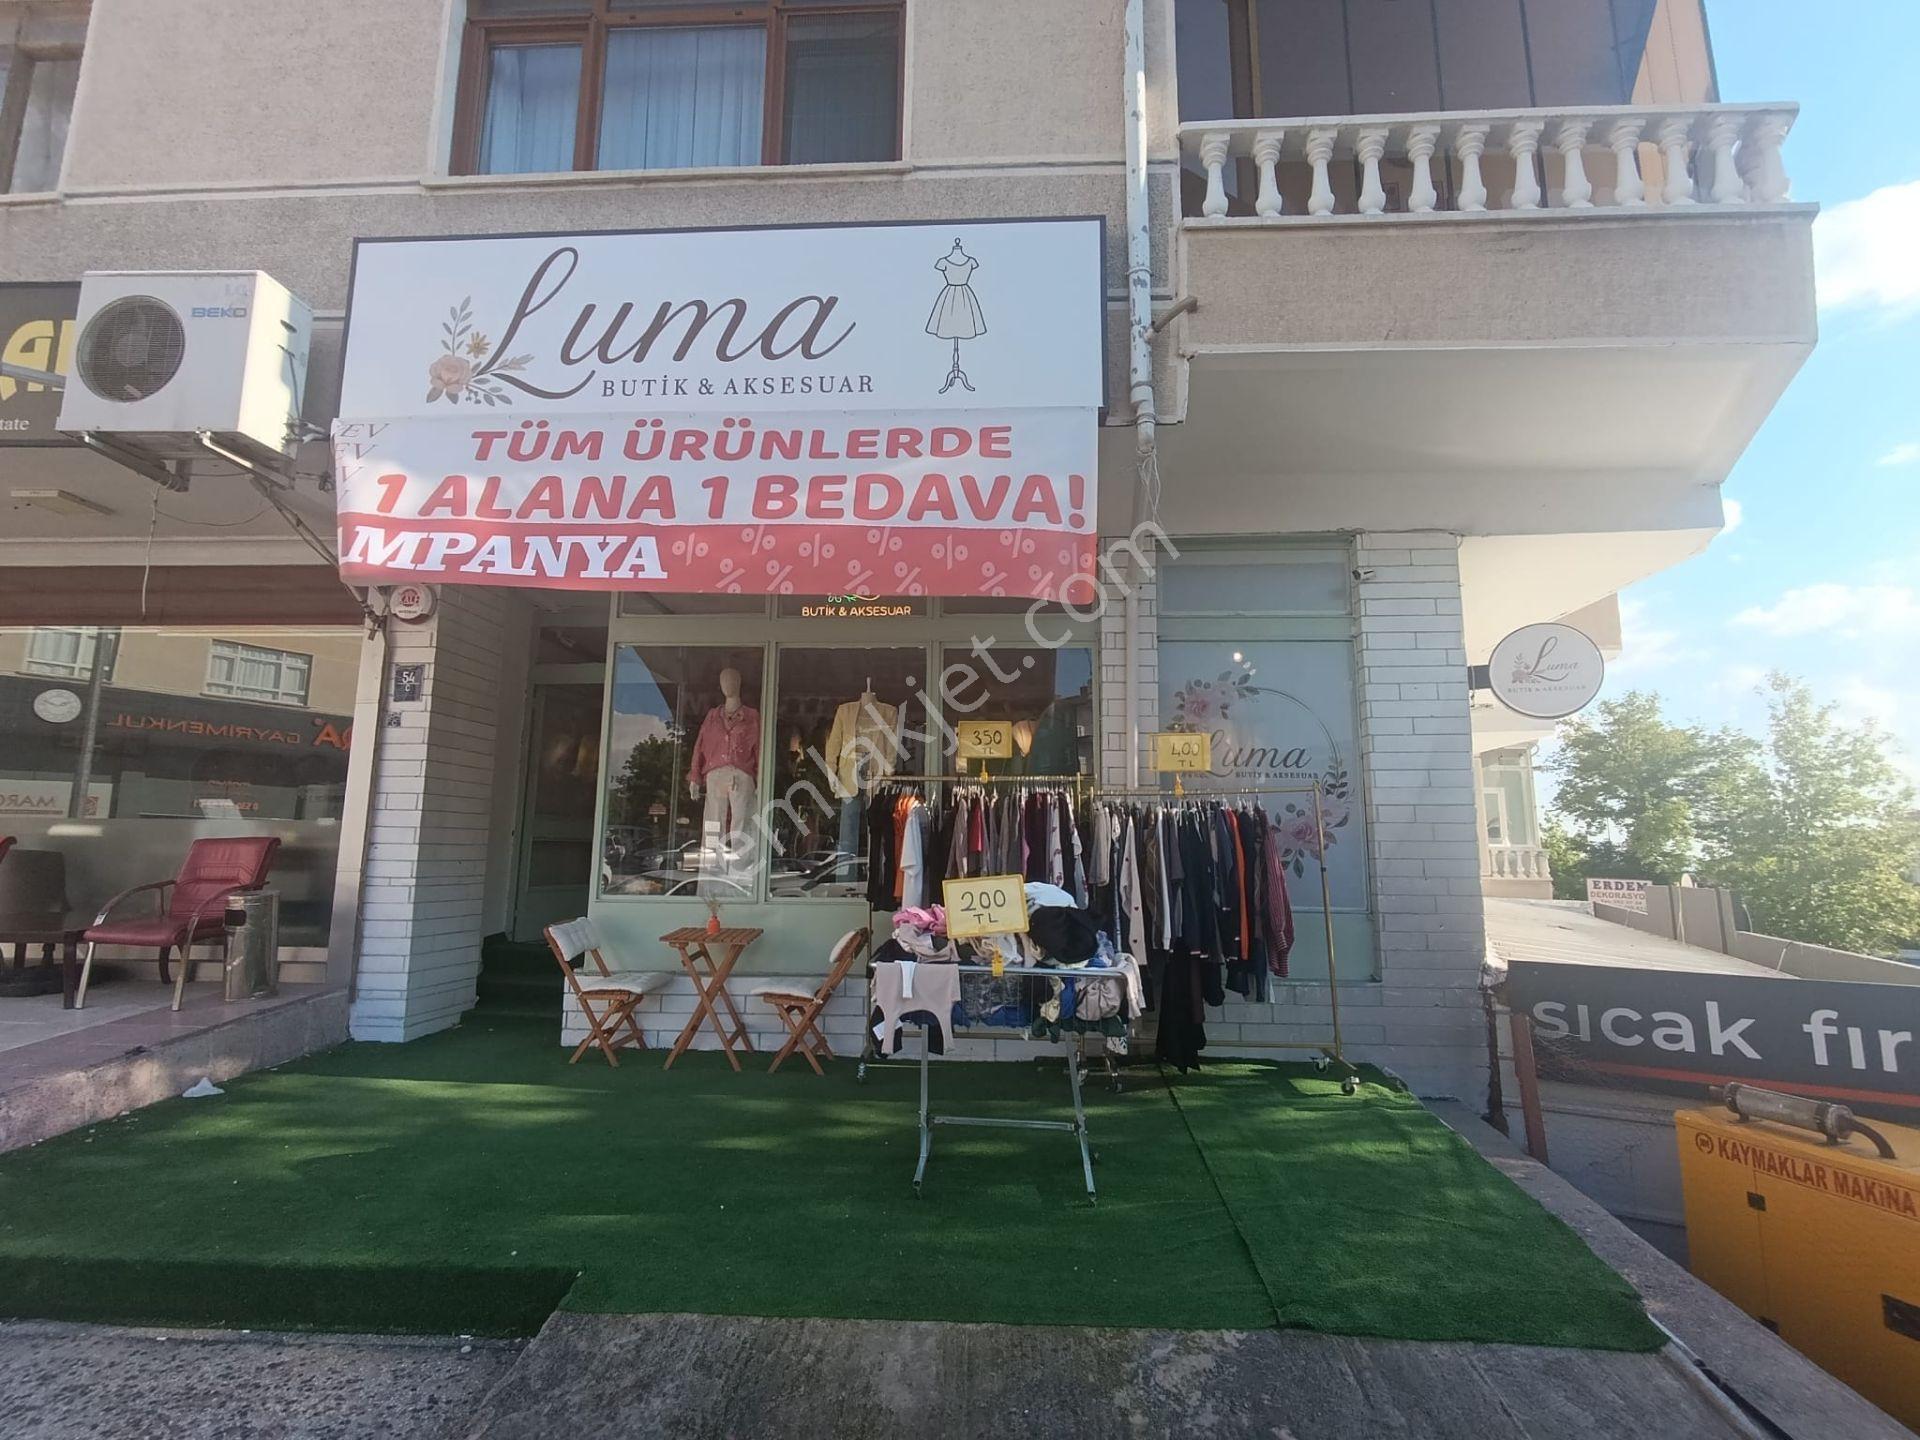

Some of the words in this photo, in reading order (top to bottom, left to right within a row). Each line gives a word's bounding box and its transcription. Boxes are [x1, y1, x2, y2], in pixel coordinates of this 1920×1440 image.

[191, 307, 247, 317] BEKO
[472, 247, 857, 400] Luma
[602, 375, 688, 397] BUTİK
[698, 378, 714, 395] &
[723, 376, 874, 394] AKSESUAR
[471, 420, 604, 461] TÜM
[623, 418, 1012, 461] ÜRÜNLERDE
[377, 474, 407, 513] 1
[417, 475, 676, 519] ALANA
[701, 476, 729, 519] 1
[751, 473, 1086, 530] BEDAVA!
[338, 525, 668, 578] MPANYA
[801, 605, 835, 616] BUTİK
[838, 606, 847, 616] &
[849, 606, 911, 616] AKSESUAR
[1527, 636, 1578, 682] Luma
[402, 671, 415, 683] 54
[971, 730, 1002, 746] 350
[1171, 742, 1201, 757] 400
[1205, 729, 1312, 778] Luma
[1178, 759, 1195, 767] TL
[960, 889, 1006, 911] 200
[973, 913, 999, 924] TL
[1532, 1000, 1762, 1060] sıcak
[1802, 1009, 1912, 1073] fır
[1717, 1137, 1828, 1190] KAYMAKLAR
